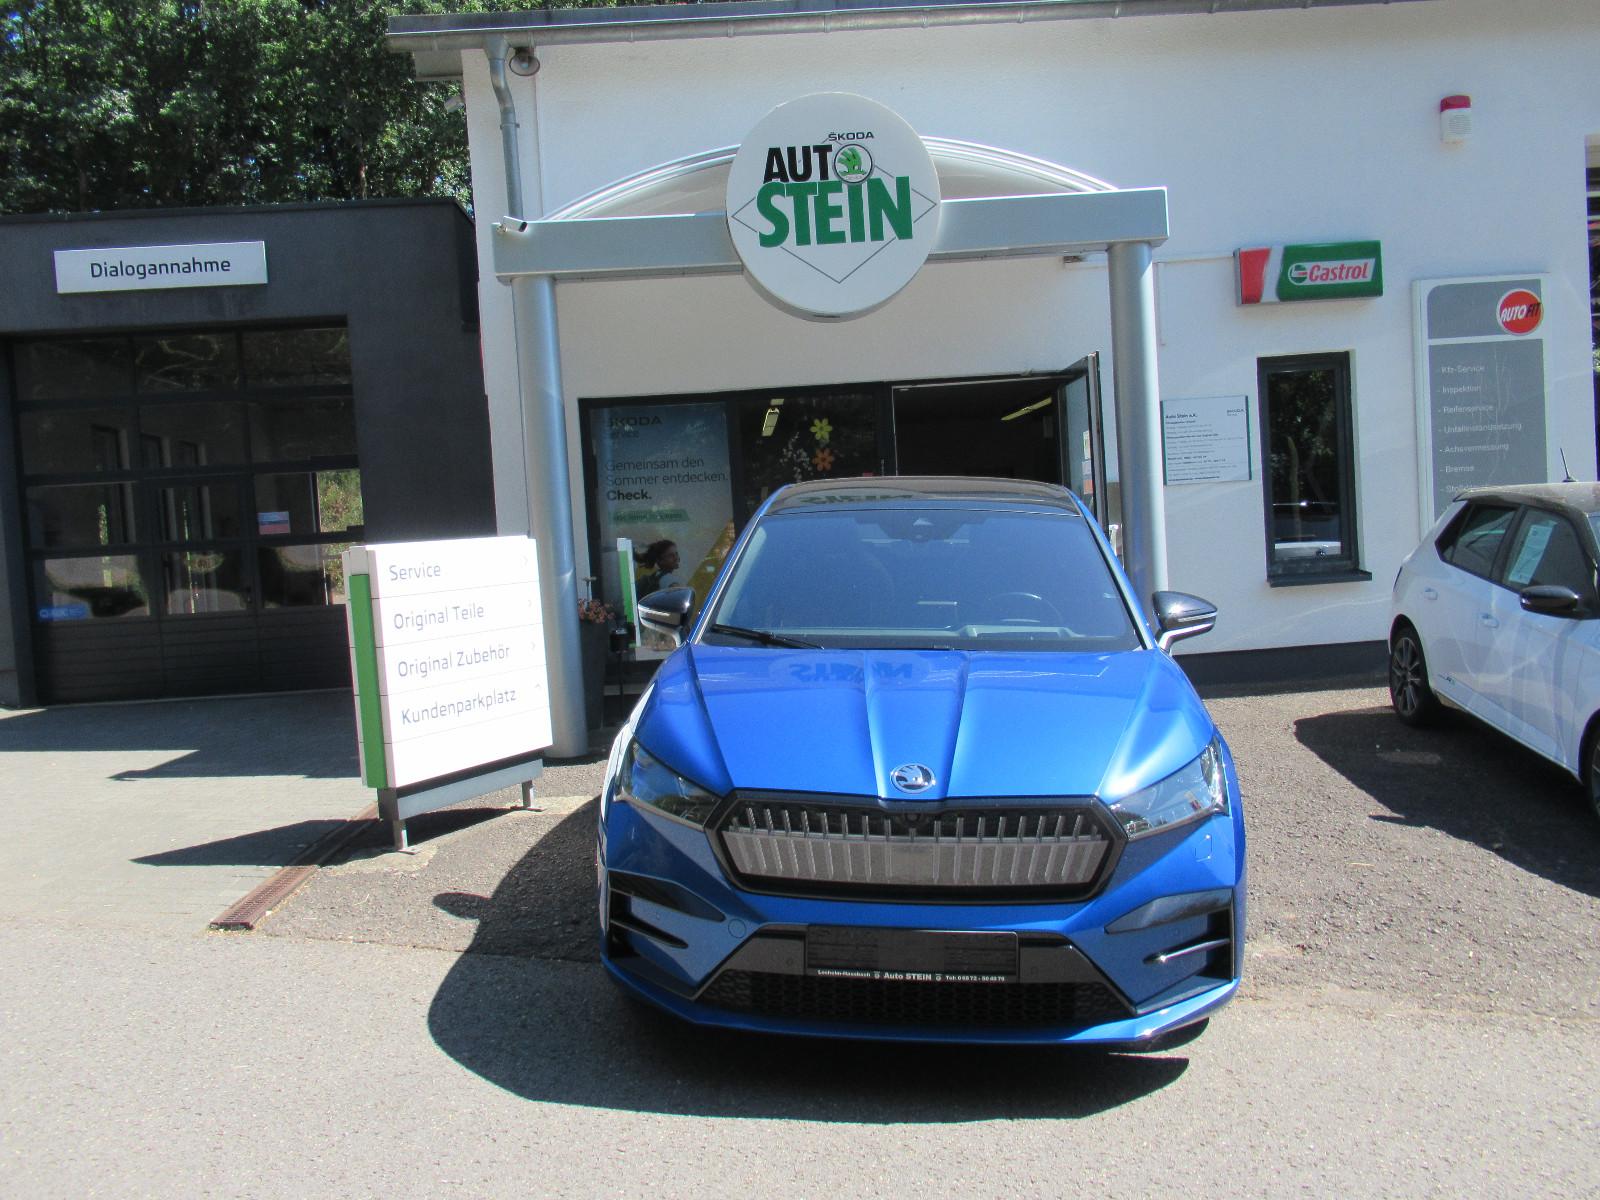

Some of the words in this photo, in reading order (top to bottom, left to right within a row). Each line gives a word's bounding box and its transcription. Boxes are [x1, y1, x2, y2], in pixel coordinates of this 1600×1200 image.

[828, 131, 874, 141] ŠKODA
[756, 176, 913, 248] STEIN
[90, 257, 231, 279] Dialogannahme
[1308, 262, 1369, 282] Castrol
[1442, 384, 1481, 395] Inspektion
[682, 456, 704, 468] den
[662, 472, 728, 484] entdecken.
[607, 489, 652, 501] Check.
[389, 562, 441, 582] Service
[394, 608, 448, 631] Original
[454, 603, 485, 620] Teile
[398, 655, 452, 678] Original
[457, 645, 510, 667] Zubehör
[402, 688, 517, 725] Kundenparkplatz
[883, 972, 903, 981] Auto
[905, 973, 931, 981] STEIN
